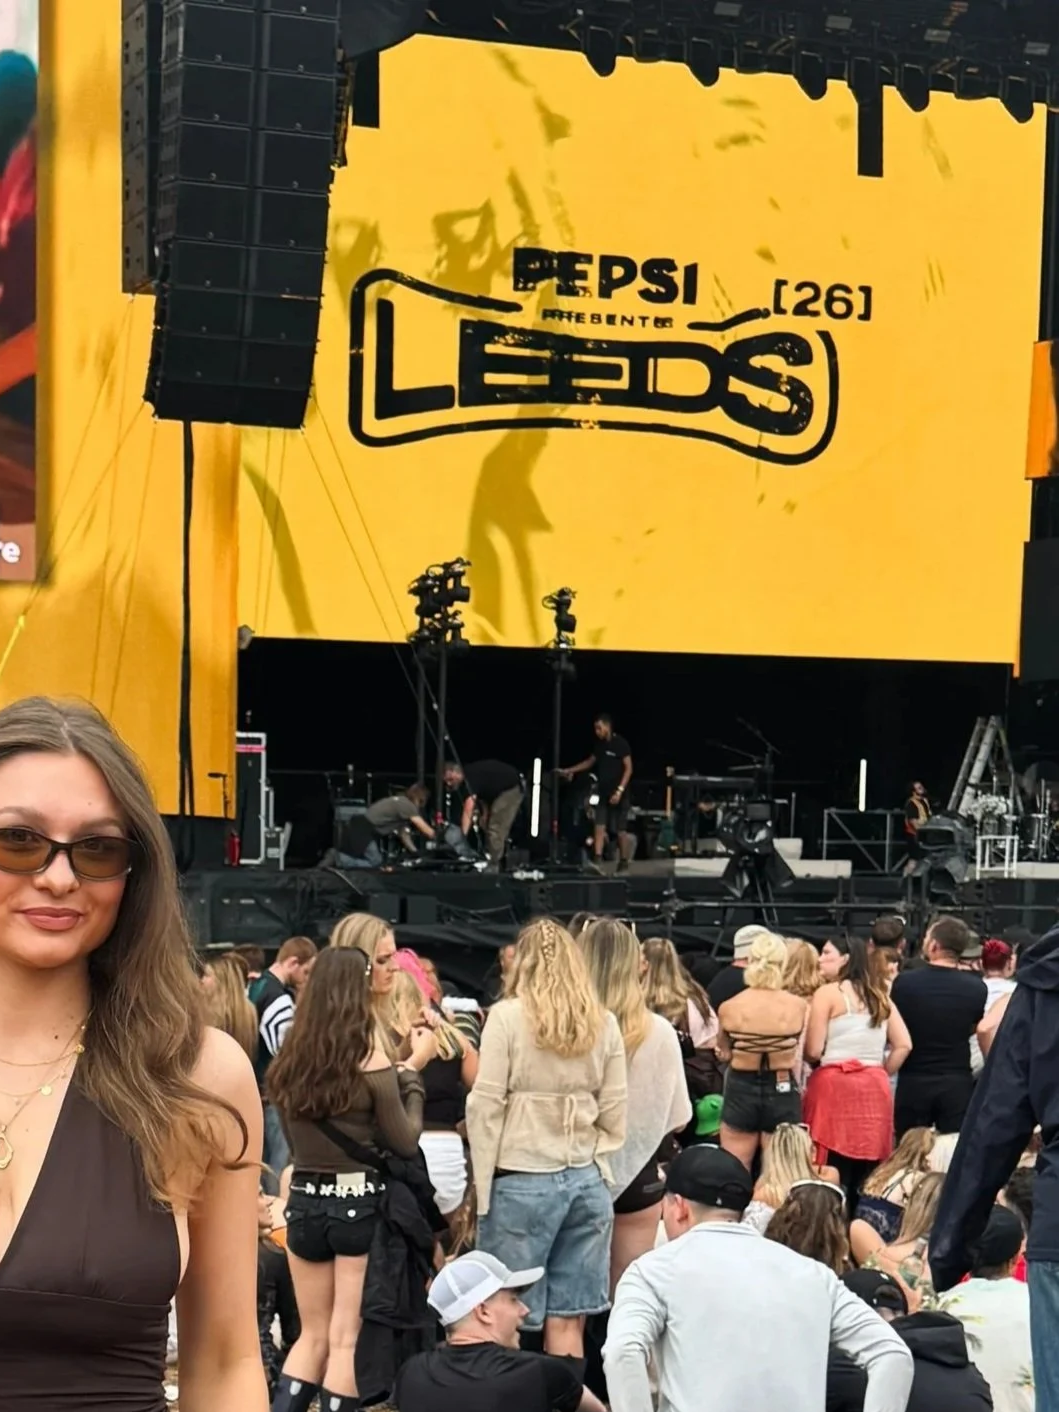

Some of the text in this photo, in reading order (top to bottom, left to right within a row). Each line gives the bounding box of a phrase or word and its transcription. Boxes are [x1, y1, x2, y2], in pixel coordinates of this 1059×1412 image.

[513, 247, 698, 305] PEPSI
[774, 279, 872, 321] [26]
[375, 297, 814, 436] LEEDS
